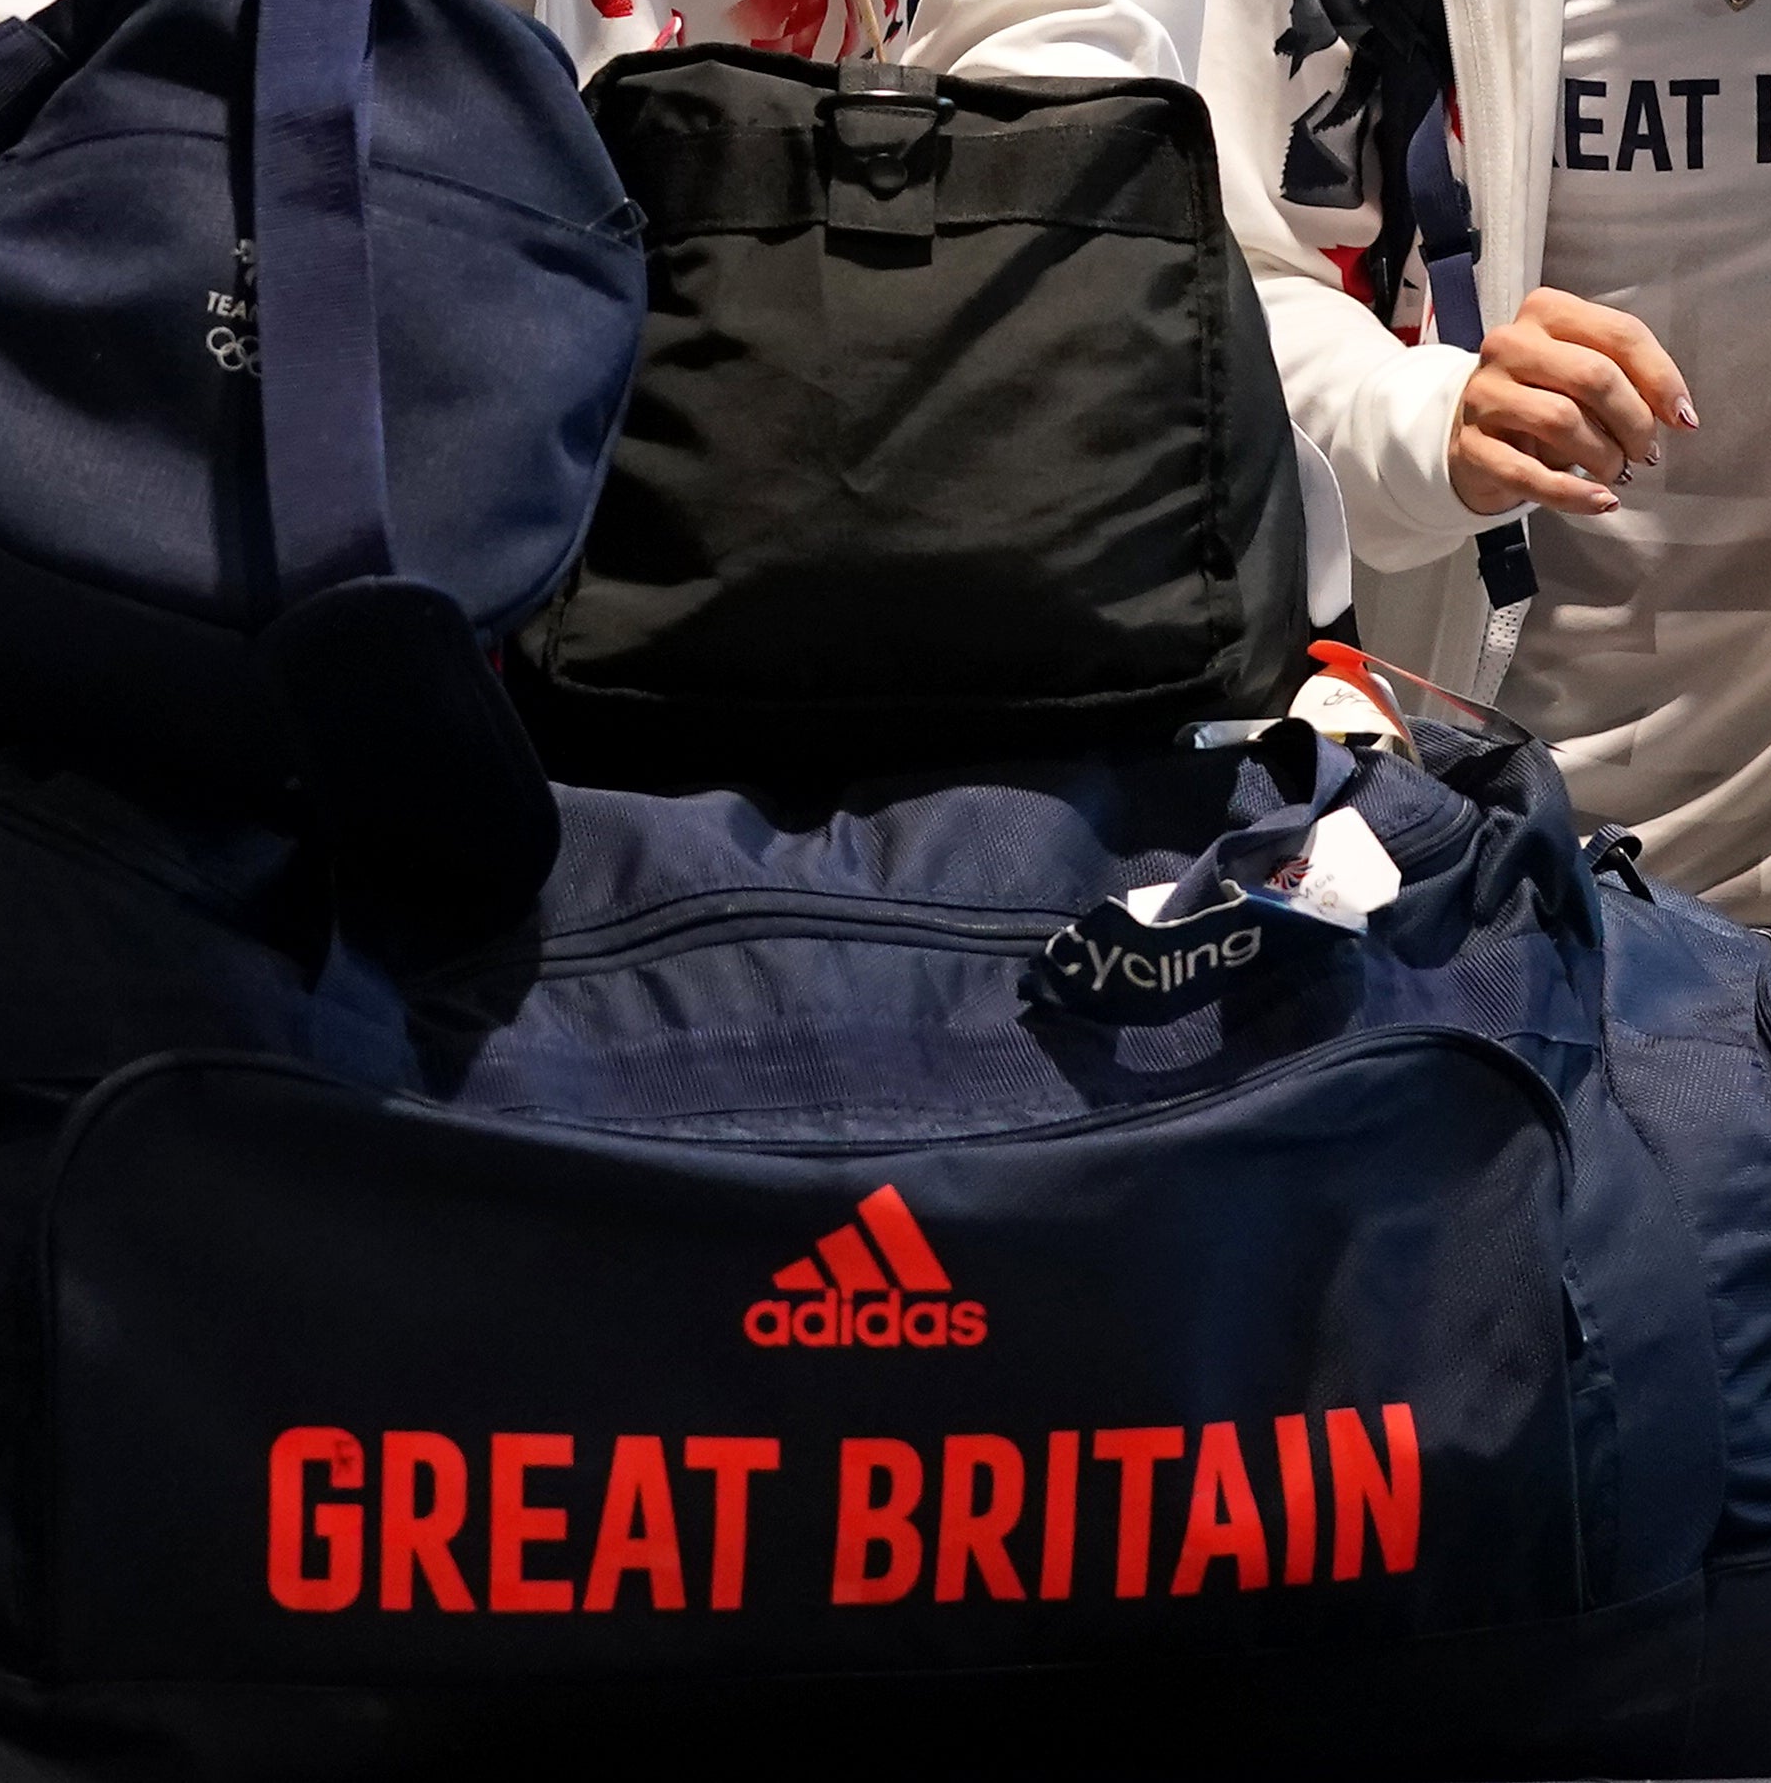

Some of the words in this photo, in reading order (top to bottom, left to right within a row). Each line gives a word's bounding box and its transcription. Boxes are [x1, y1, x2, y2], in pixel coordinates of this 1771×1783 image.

[1553, 78, 1720, 171] EAT
[207, 290, 258, 321] TEA
[1045, 923, 1262, 993] Cycling
[744, 1289, 987, 1348] adidas
[267, 1426, 779, 1613] GREAT
[830, 1403, 1422, 1605] BRITAIN
